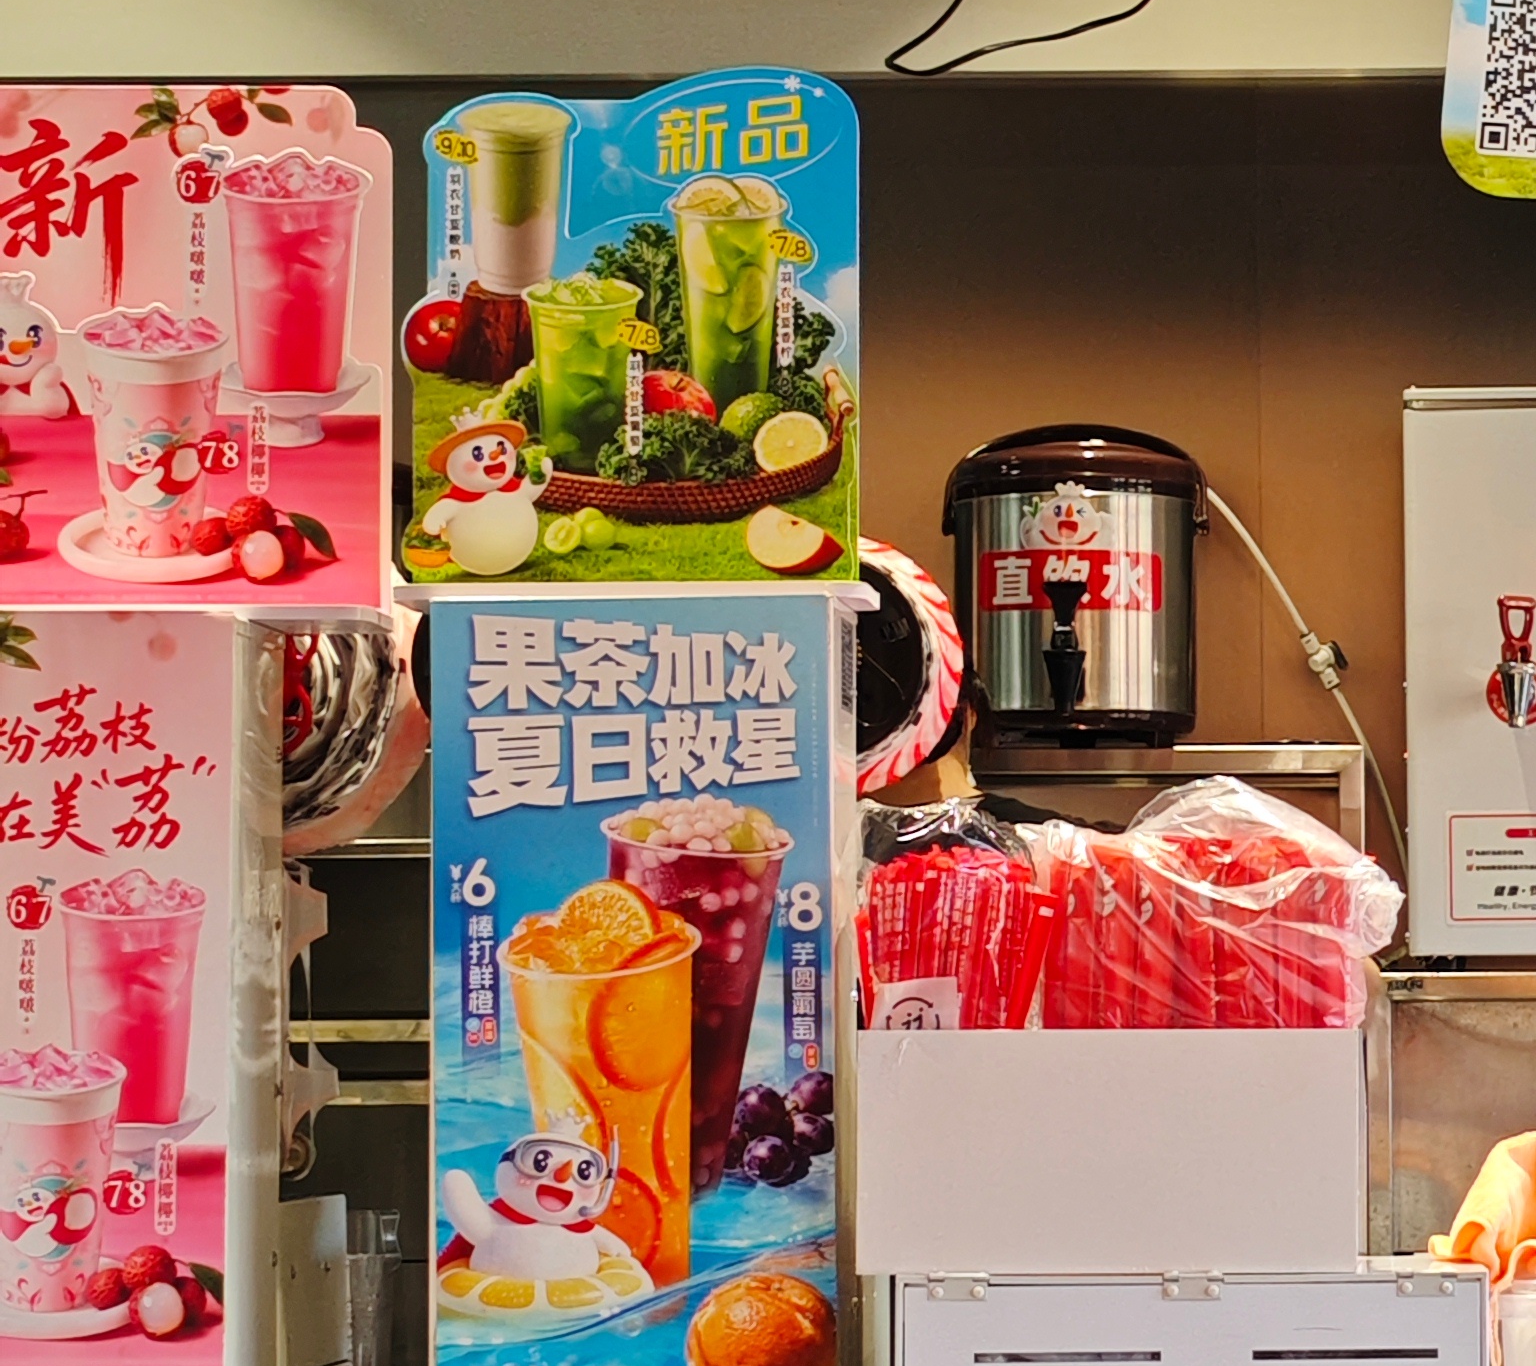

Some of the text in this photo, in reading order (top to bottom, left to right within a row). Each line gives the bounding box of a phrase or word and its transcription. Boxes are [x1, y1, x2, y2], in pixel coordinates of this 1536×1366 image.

[656, 94, 809, 176] 新品
[0, 117, 139, 307] 新
[467, 614, 799, 711] 果茶加冰
[466, 708, 801, 819] 夏日救星
[468, 914, 495, 1015] 棒打鲜橙
[791, 941, 817, 1041] 芋圆葡萄
